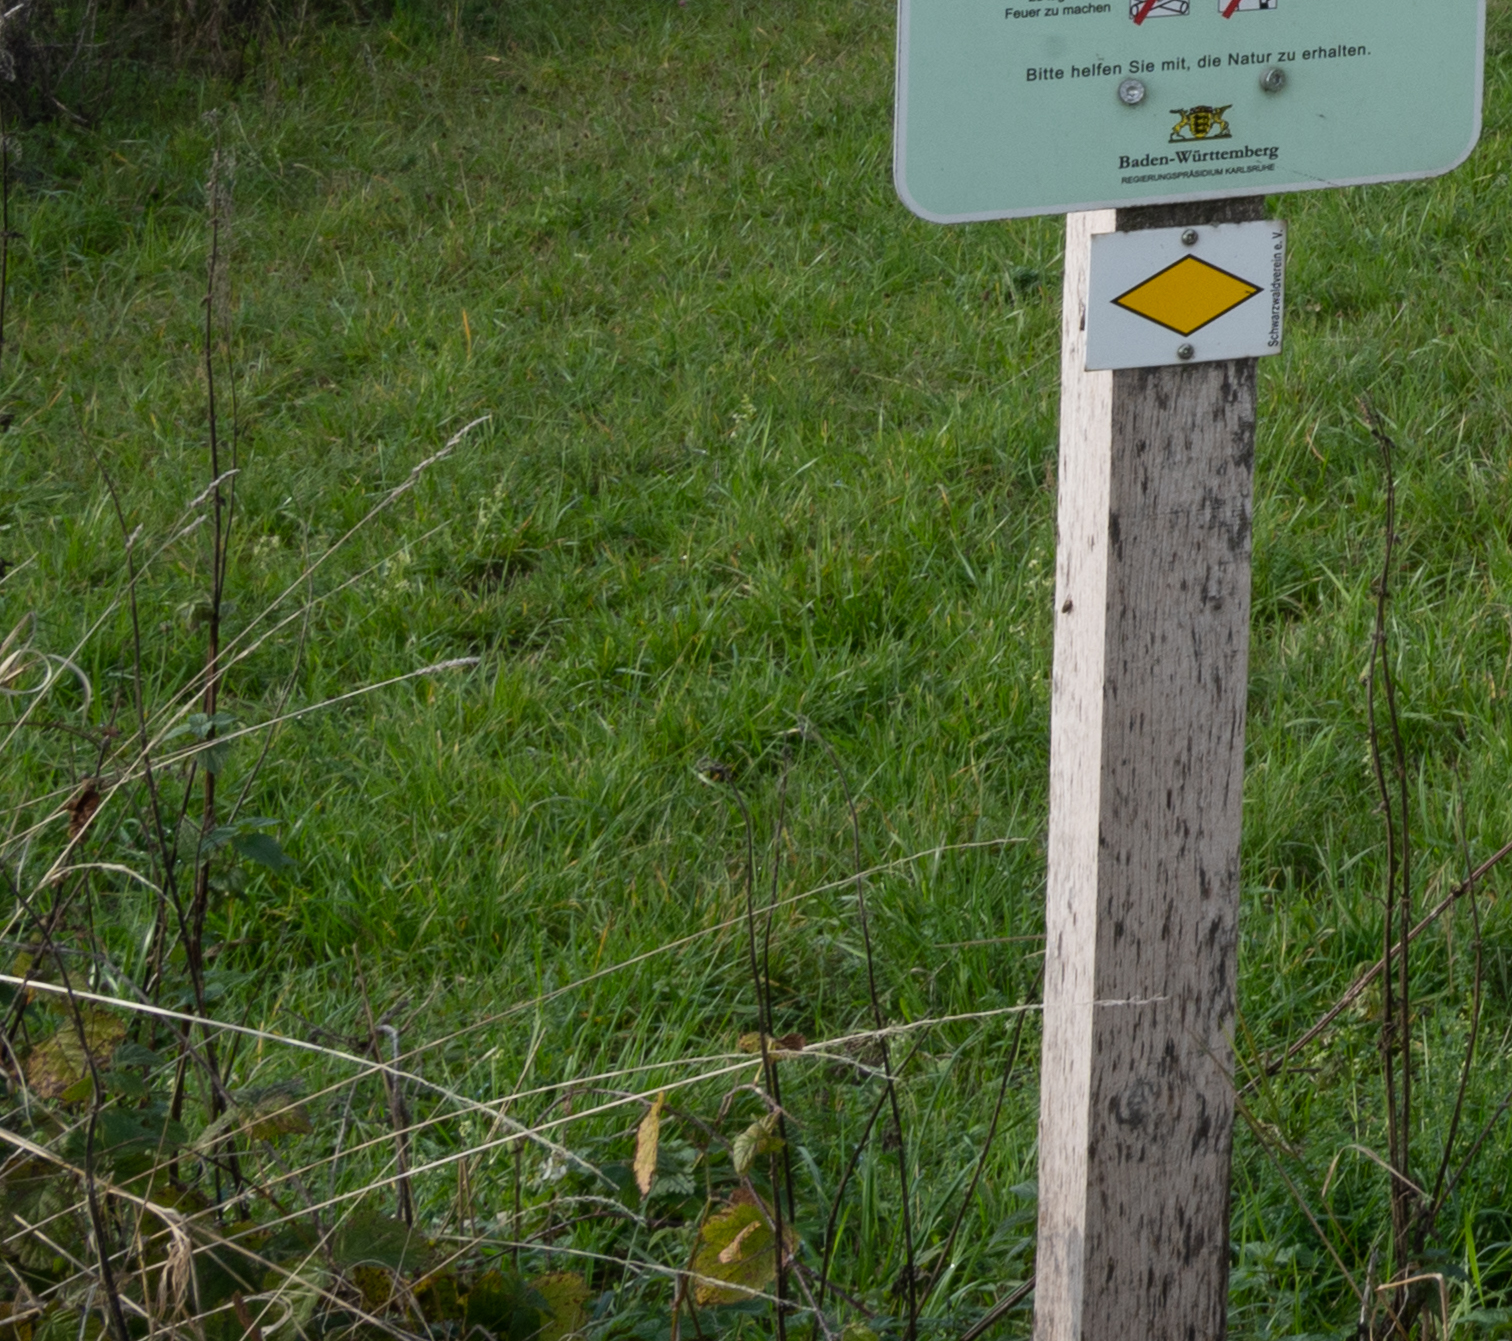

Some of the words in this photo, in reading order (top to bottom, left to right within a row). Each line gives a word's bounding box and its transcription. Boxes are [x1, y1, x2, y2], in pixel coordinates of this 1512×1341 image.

[1004, 7, 1042, 20] Feuer
[1044, 7, 1060, 17] zu
[1062, 2, 1111, 15] machen
[1026, 67, 1065, 82] Bitte
[1070, 61, 1122, 78] helfen
[1128, 59, 1155, 74] Sie
[1161, 57, 1191, 72] mit,
[1197, 54, 1222, 69] die
[1227, 51, 1273, 66] Natur
[1275, 52, 1296, 64] zu
[1301, 44, 1373, 61] erhalten.
[1118, 145, 1279, 169] Baden-Württemberg
[1121, 168, 1223, 184] REGIERUNGSPRÄSIDIUM
[1225, 163, 1275, 175] KARLSRUHE
[1271, 228, 1284, 239] V.
[1267, 252, 1283, 348] Schwarzwaldverein
